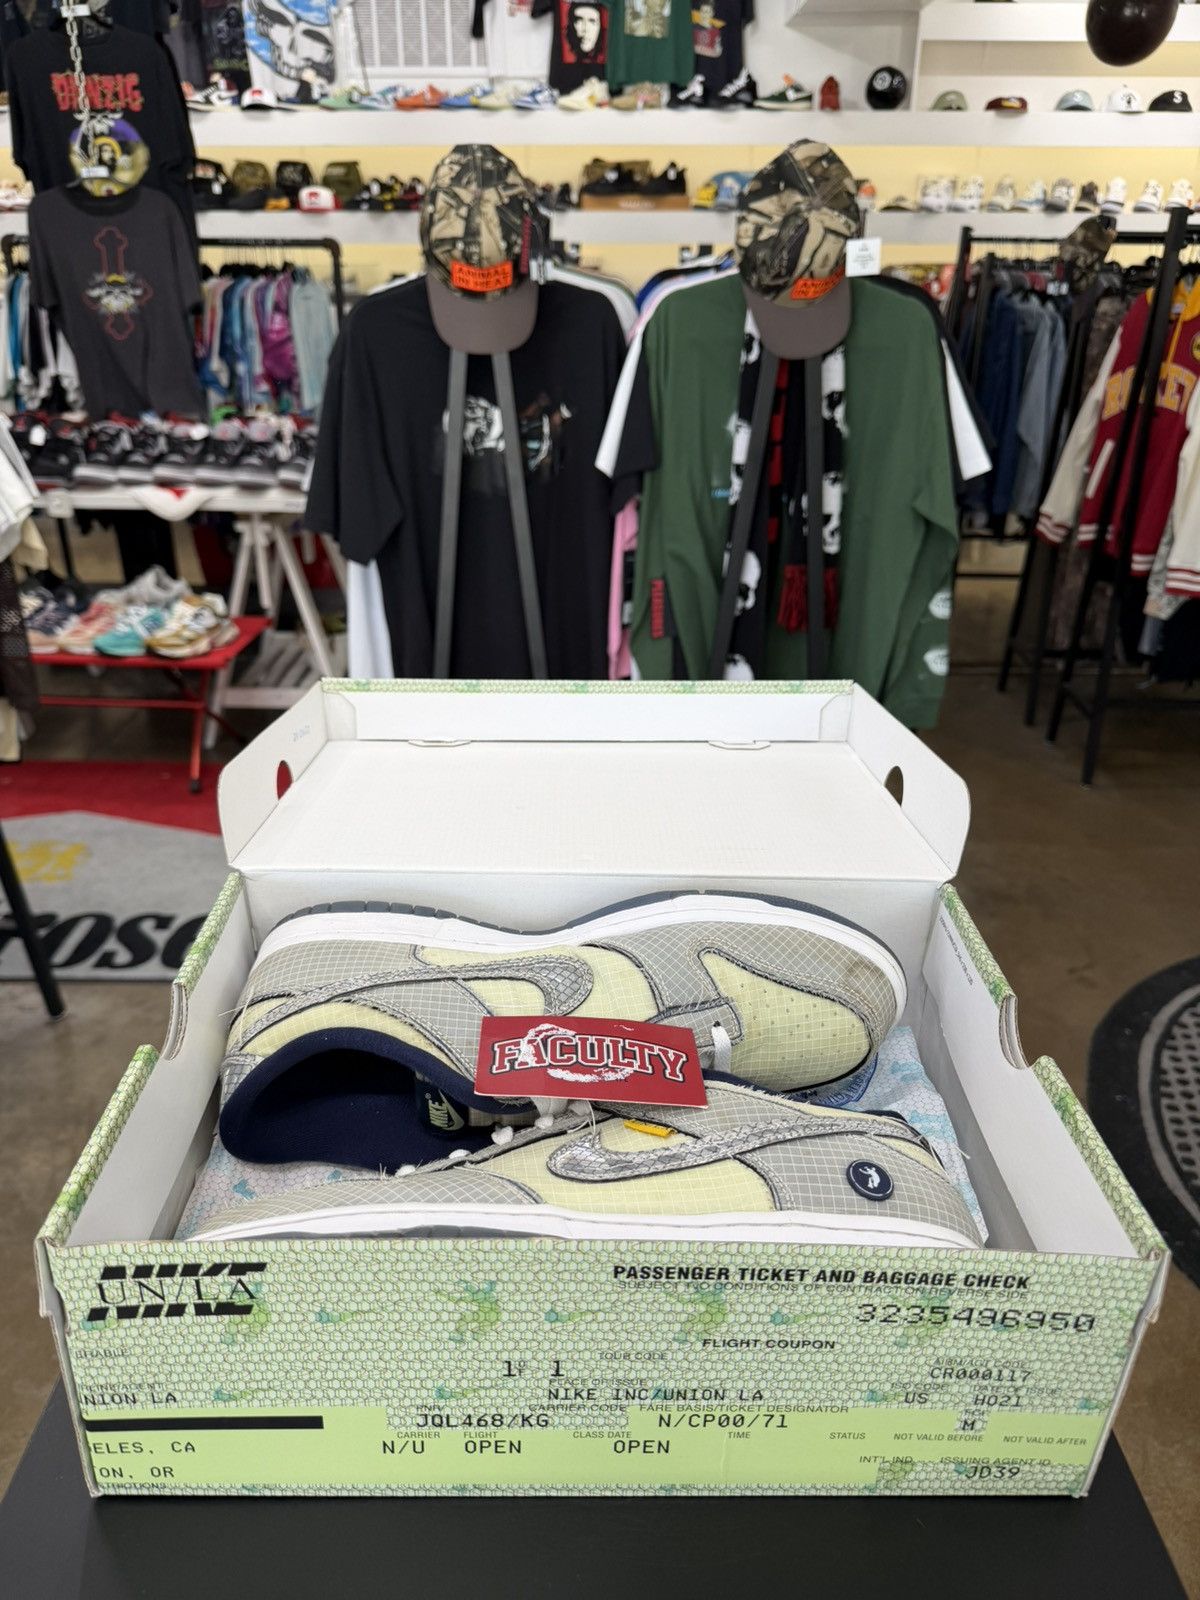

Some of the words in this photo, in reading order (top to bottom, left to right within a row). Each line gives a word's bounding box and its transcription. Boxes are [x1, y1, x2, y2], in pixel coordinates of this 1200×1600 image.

[492, 1031, 687, 1083] FACULTY
[428, 1100, 448, 1128] NIKE
[614, 1266, 730, 1280] PASSENGER
[738, 1268, 809, 1283] TICKET
[815, 1269, 856, 1283] AND
[862, 1270, 956, 1287] BAGGAGE
[963, 1273, 1030, 1290] CHECK
[856, 1303, 1096, 1332] 3235496950
[702, 1338, 760, 1348] FLIGHT
[766, 1339, 835, 1349] COUPON
[503, 1360, 516, 1377] 1
[551, 1360, 565, 1377] 1
[80, 1393, 137, 1406] NION
[151, 1392, 177, 1404] LA
[549, 1388, 598, 1401] NIKE
[613, 1389, 726, 1401] INC/UNION
[739, 1390, 764, 1401] LA
[904, 1393, 928, 1404] US
[529, 1404, 587, 1412] CARRIER
[640, 1404, 672, 1412] FARE
[416, 1413, 549, 1428] JQL468/KG
[962, 1420, 976, 1431] M
[397, 1431, 441, 1439] CARRIER
[463, 1431, 497, 1439] FLIGHT
[572, 1431, 605, 1439] CLASS
[607, 1431, 632, 1439] DATE
[728, 1431, 751, 1439] TIME
[829, 1432, 866, 1440] STATUS
[893, 1433, 913, 1441] NOT
[916, 1433, 945, 1441] VALID
[947, 1434, 983, 1442] BEFORE
[1002, 1435, 1023, 1443] NOT
[1026, 1436, 1054, 1444] VALID
[1056, 1437, 1087, 1445] AFTER
[88, 1441, 155, 1455] ELES,
[171, 1441, 196, 1453] CA
[382, 1440, 425, 1454] N/U
[464, 1440, 522, 1454] OPEN
[613, 1439, 670, 1454] OPEN
[150, 1466, 175, 1478] OR
[965, 1465, 1020, 1479] JD39
